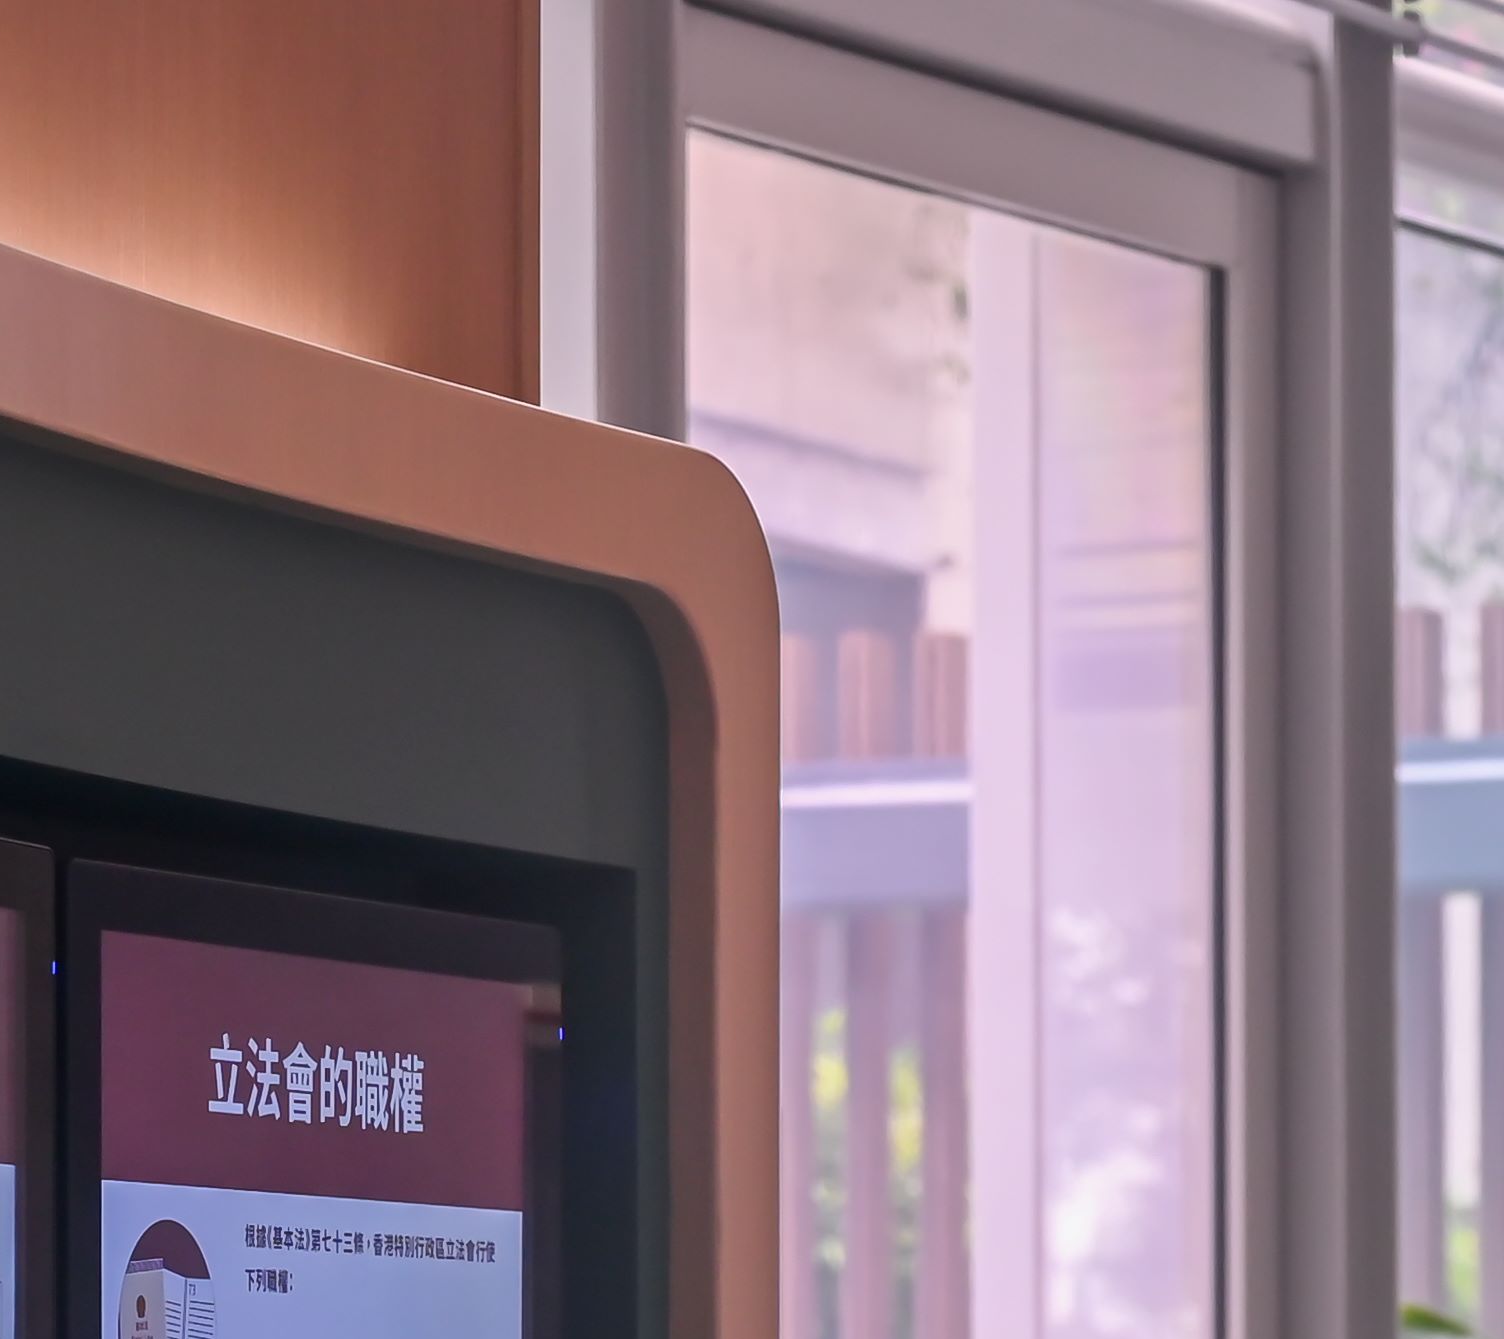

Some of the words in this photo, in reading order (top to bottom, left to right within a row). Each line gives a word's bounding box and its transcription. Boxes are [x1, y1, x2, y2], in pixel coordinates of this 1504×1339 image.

[207, 1032, 425, 1134] 立法會的職權
